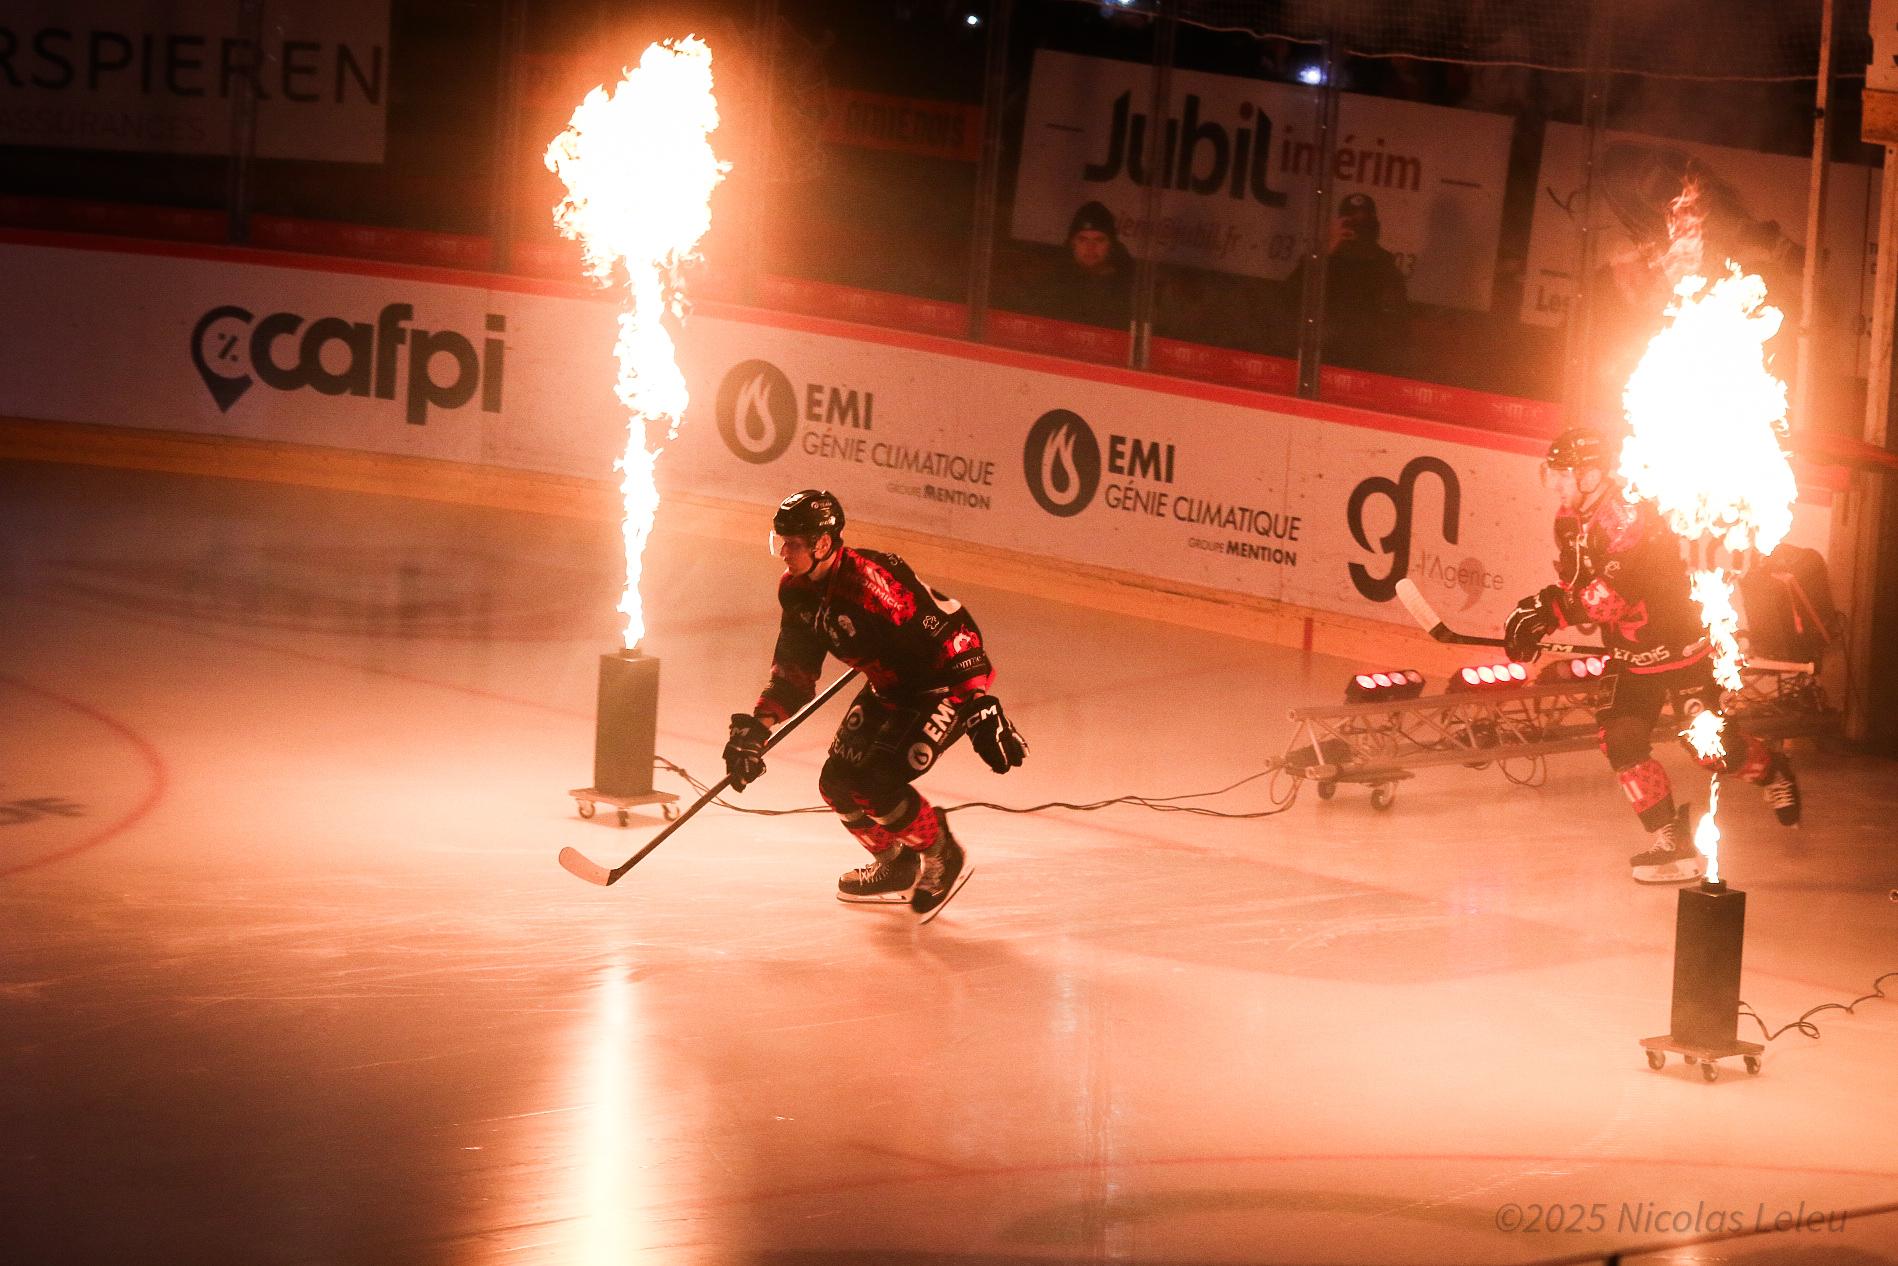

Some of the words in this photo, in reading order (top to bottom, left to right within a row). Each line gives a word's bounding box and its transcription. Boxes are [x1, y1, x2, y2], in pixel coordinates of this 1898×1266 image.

[1083, 89, 1288, 207] Jubil
[1281, 124, 1422, 192] inérim
[250, 303, 506, 426] cafpi
[805, 383, 875, 431] EMI
[802, 427, 867, 464] GÉNIE
[870, 442, 996, 487] CLIMATIQUE
[1107, 434, 1176, 485] EMI
[1104, 479, 1169, 518] GÉNIE
[1172, 496, 1302, 542] CLIMATIQUE
[1225, 539, 1298, 568] MENTION
